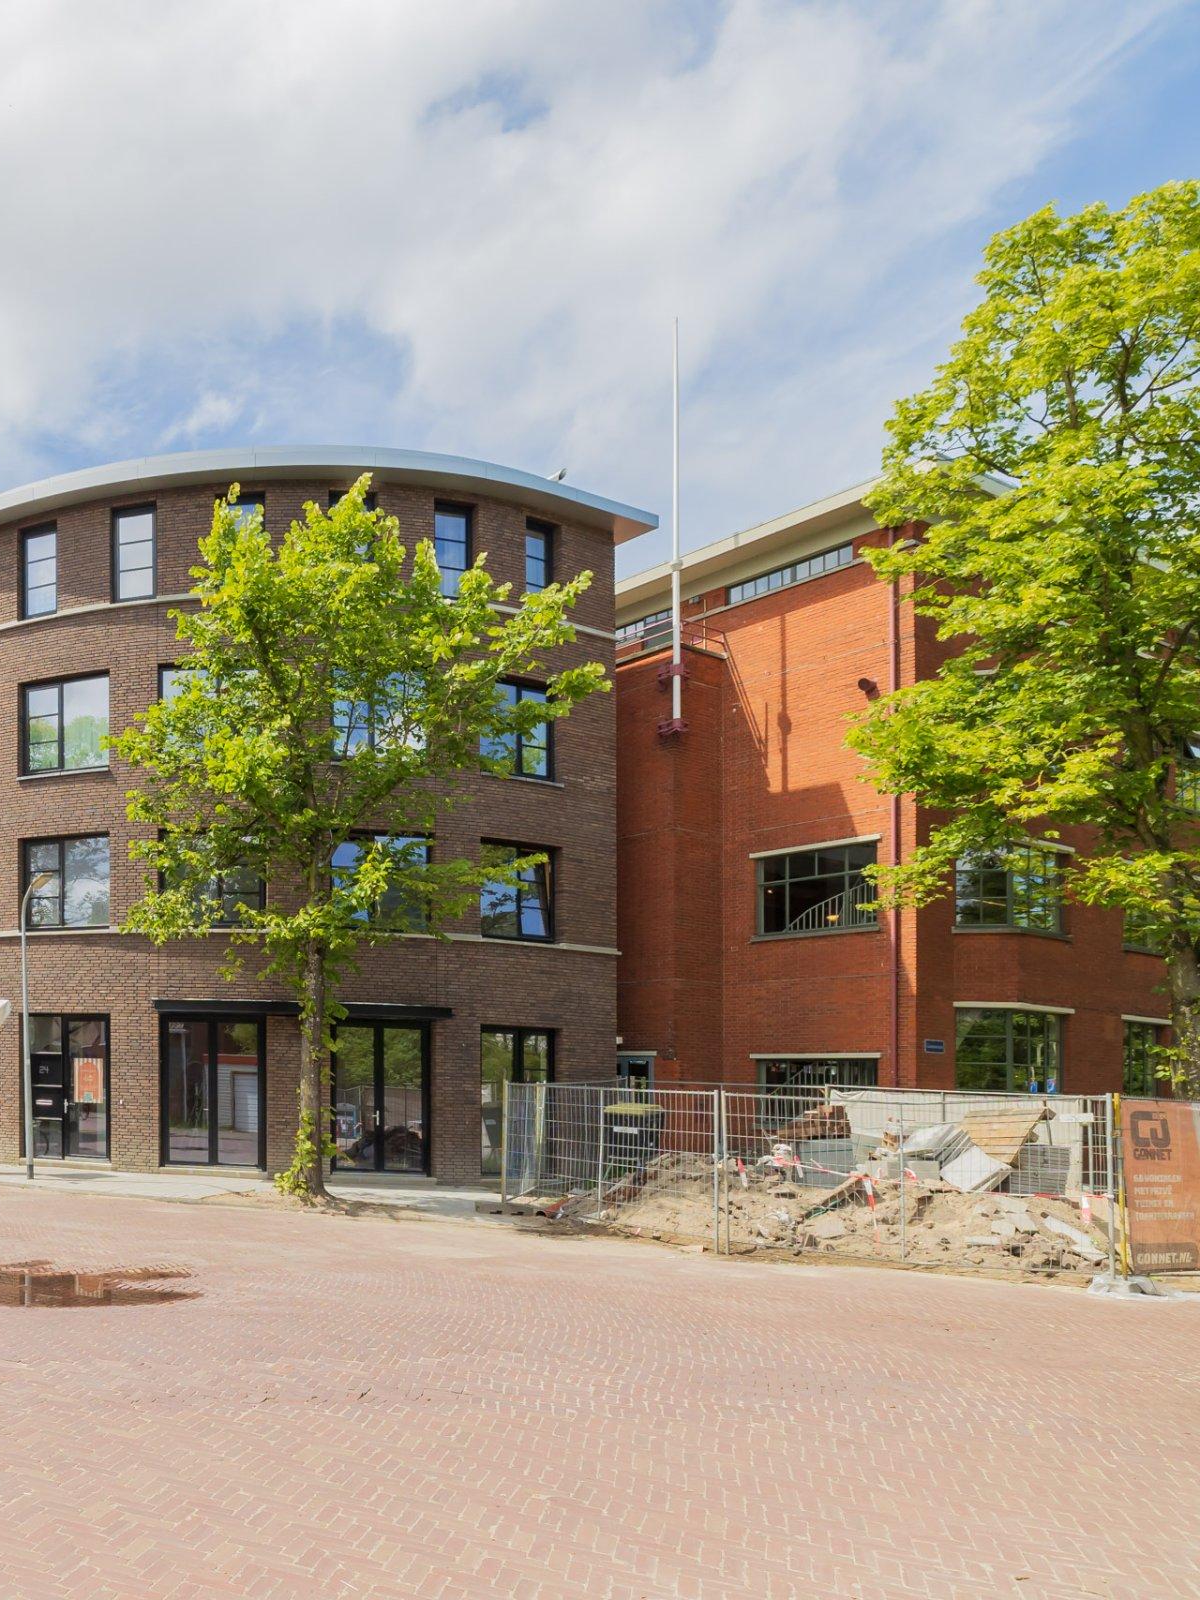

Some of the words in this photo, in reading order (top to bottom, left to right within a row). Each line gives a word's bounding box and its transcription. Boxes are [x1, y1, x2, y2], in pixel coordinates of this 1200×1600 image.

[39, 1065, 49, 1074] 24
[1133, 1149, 1172, 1161] GONNET
[1136, 1252, 1191, 1265] GONNET.NL
